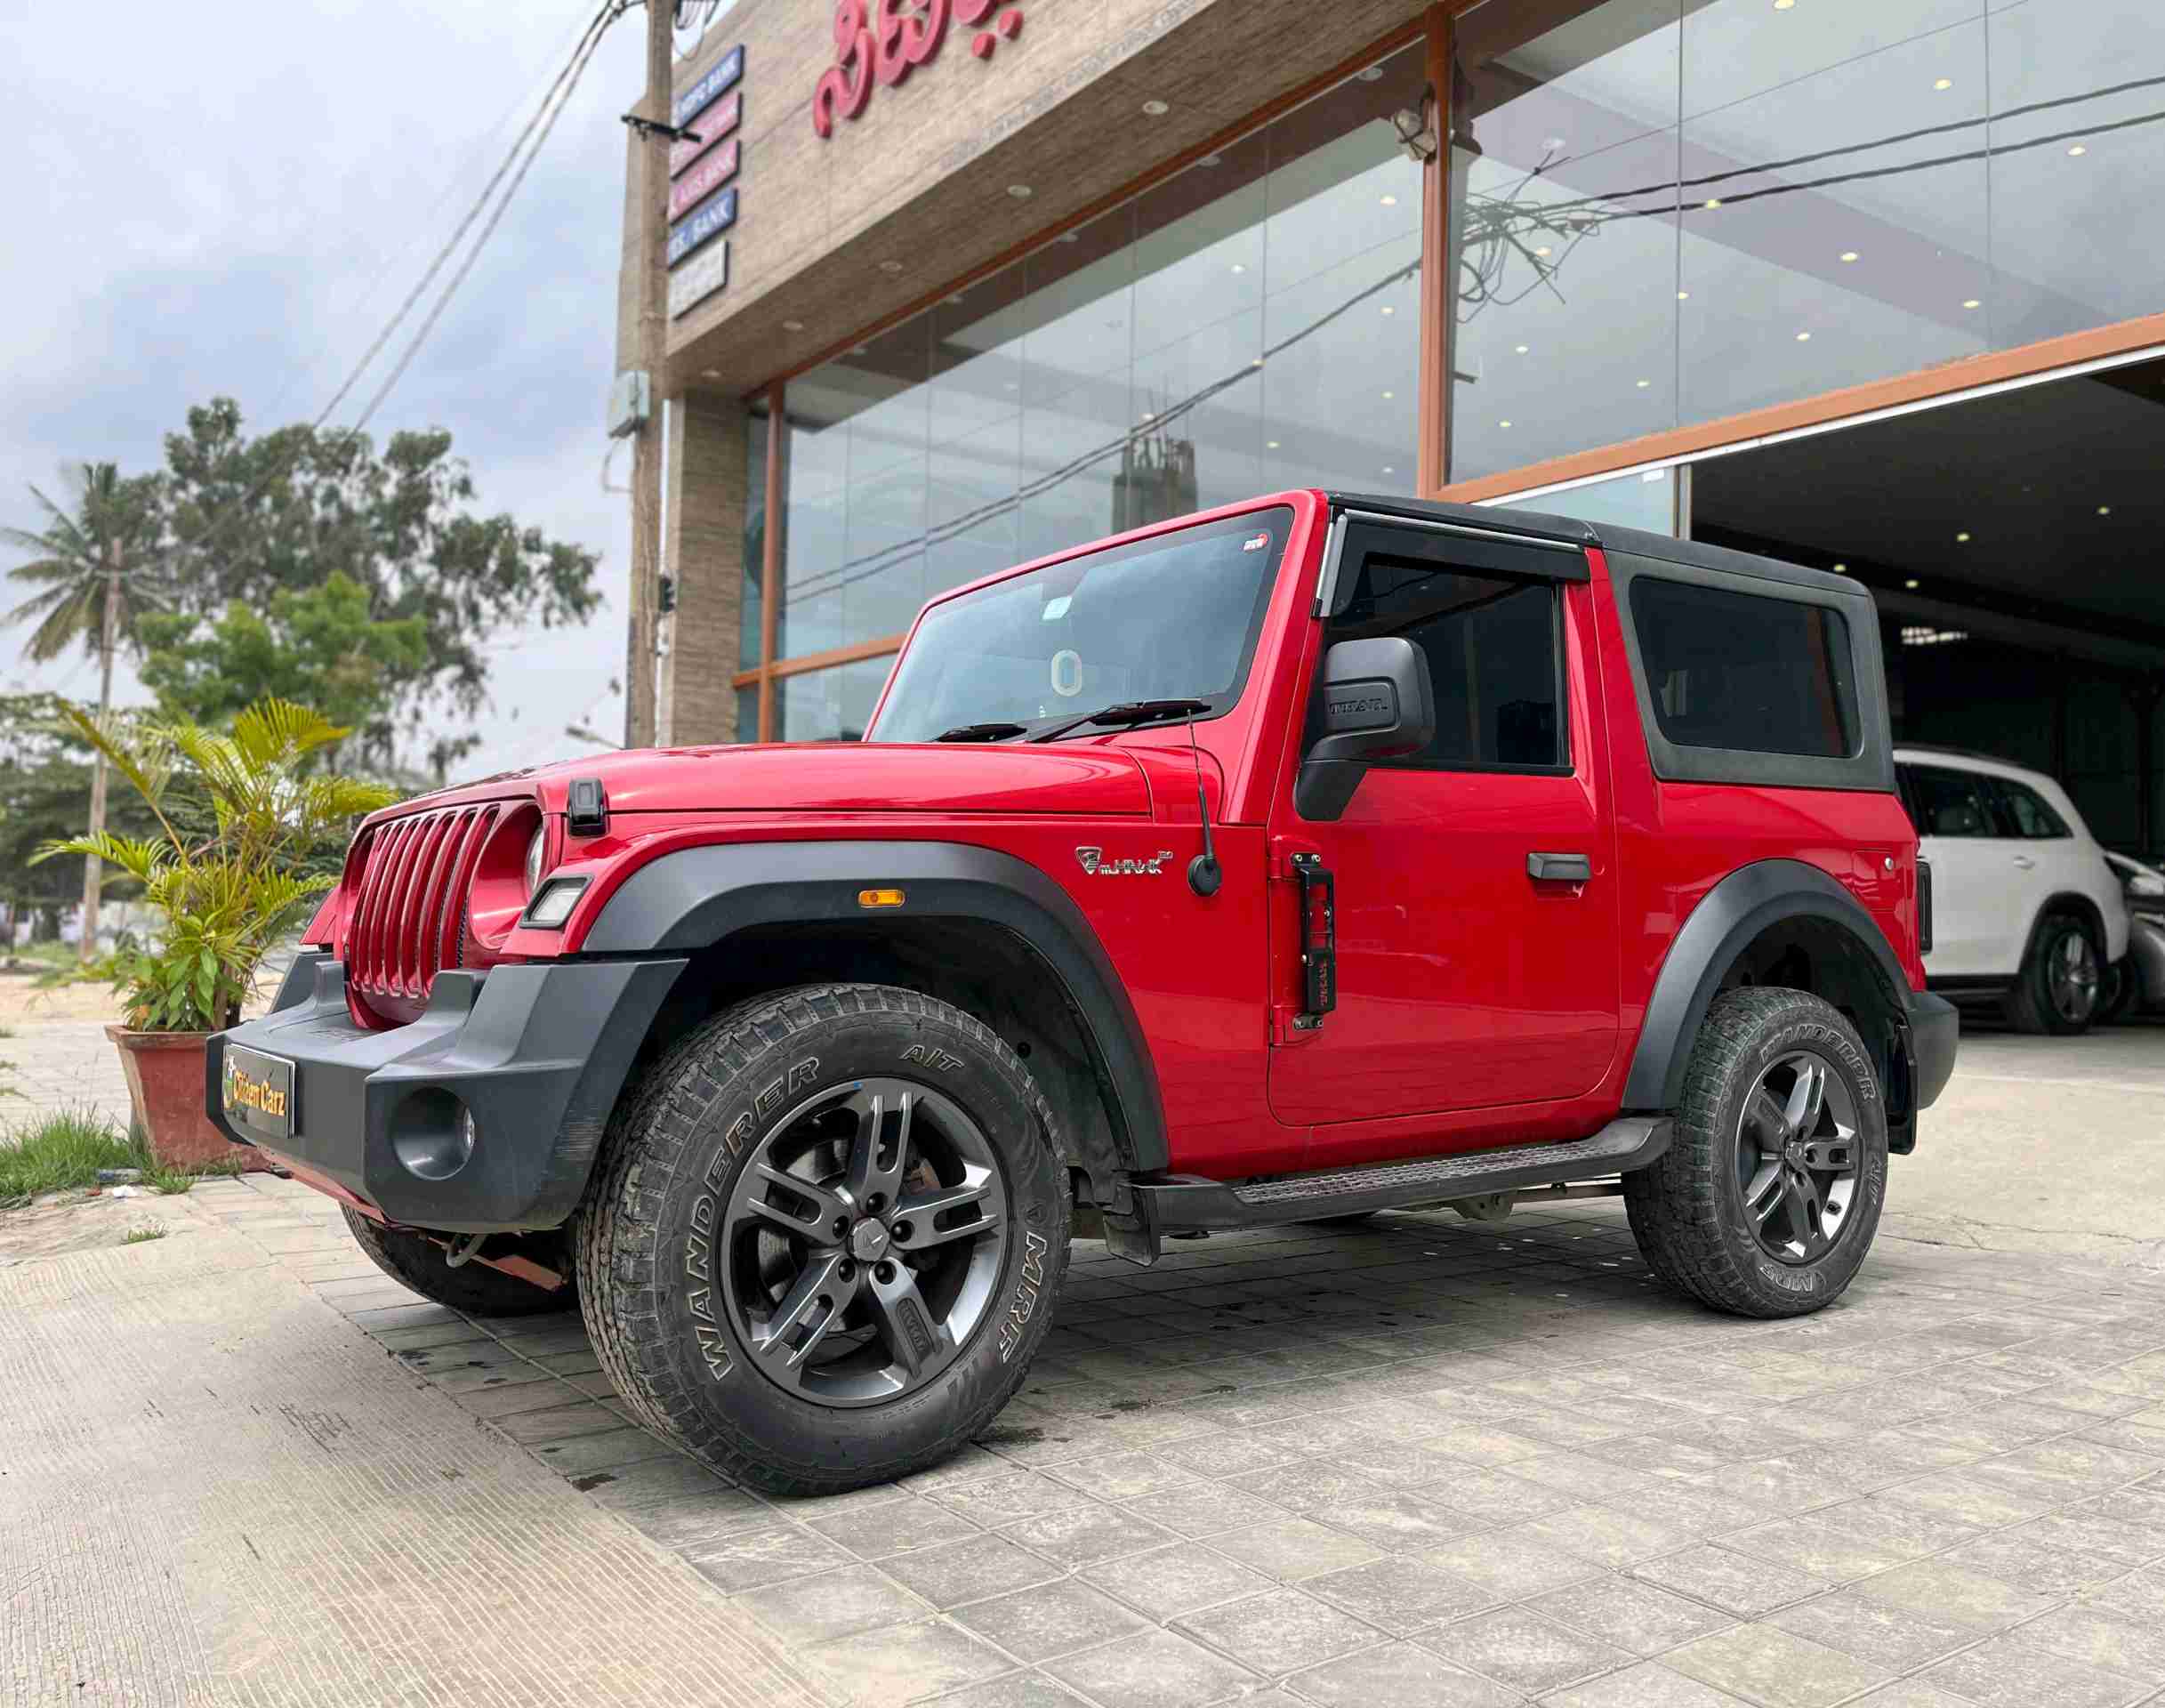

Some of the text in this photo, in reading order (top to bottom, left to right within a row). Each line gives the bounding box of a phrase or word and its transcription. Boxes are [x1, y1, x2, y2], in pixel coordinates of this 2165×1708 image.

[260, 1079, 286, 1116] Carz
[898, 1043, 965, 1071] A/T
[685, 1055, 820, 1382] WANDERER
[998, 1230, 1048, 1364] MRF
